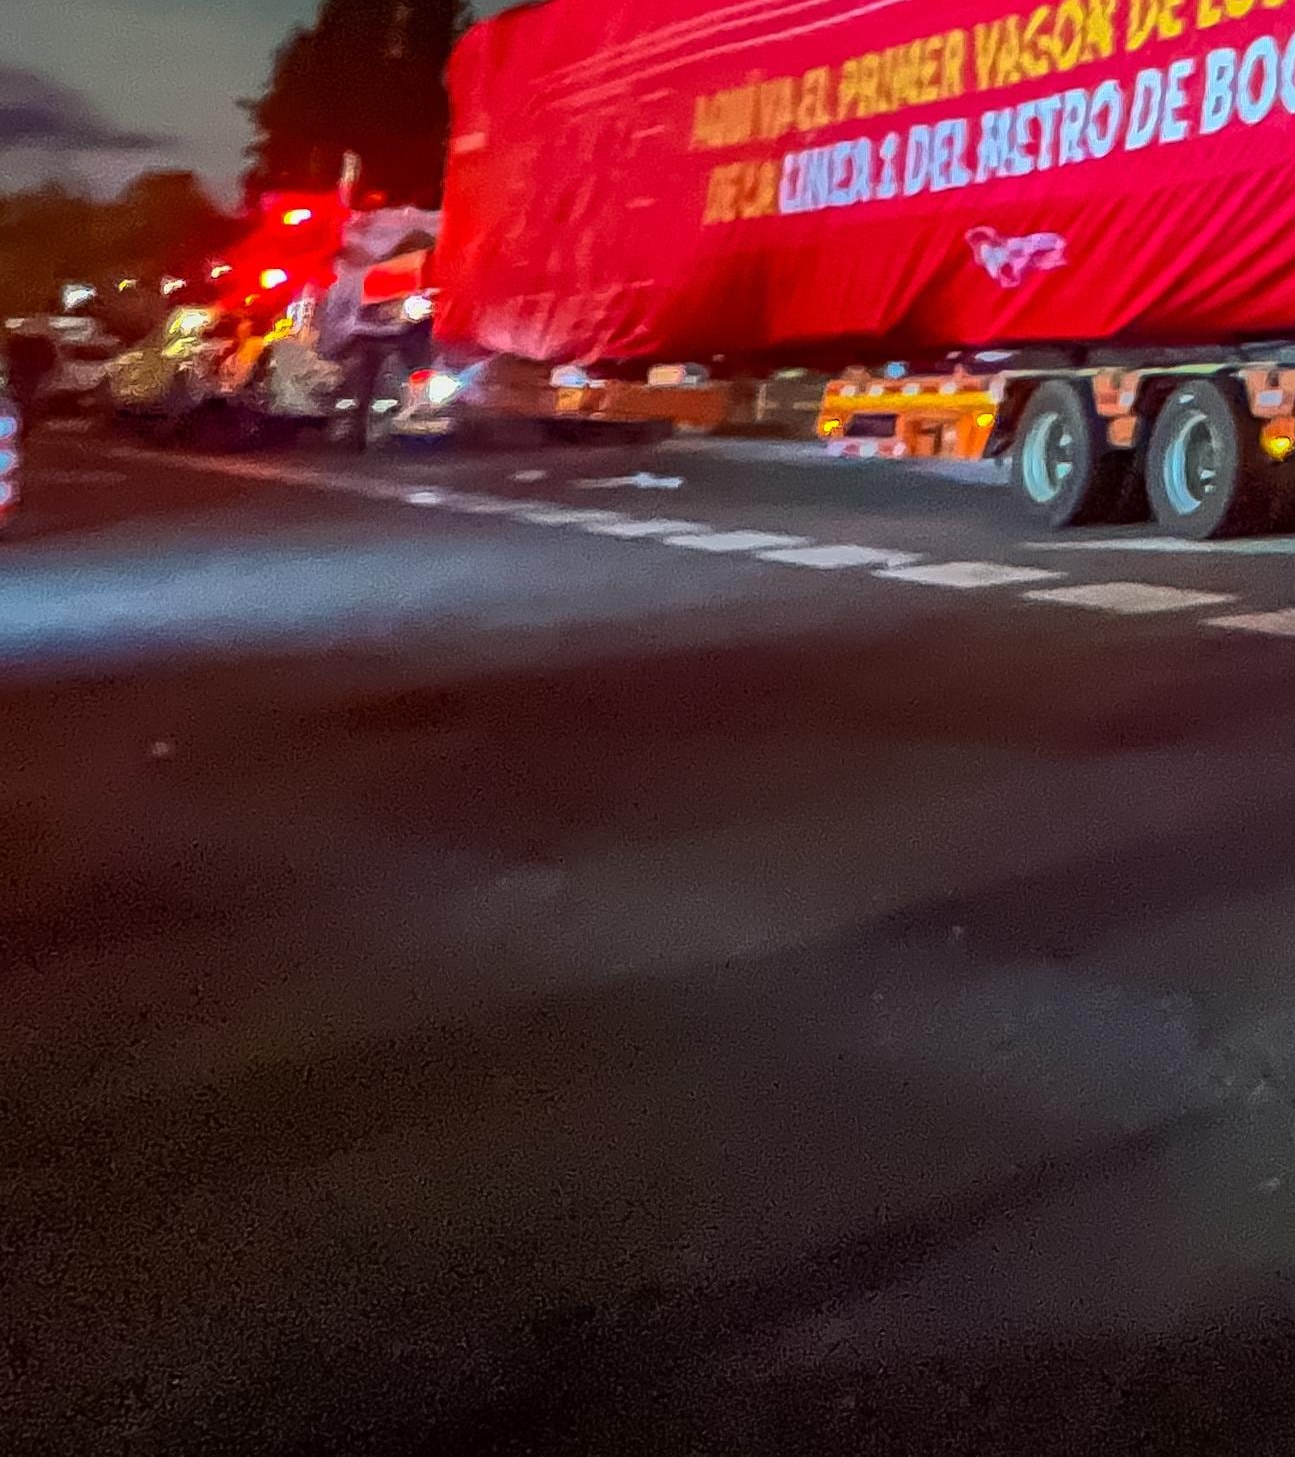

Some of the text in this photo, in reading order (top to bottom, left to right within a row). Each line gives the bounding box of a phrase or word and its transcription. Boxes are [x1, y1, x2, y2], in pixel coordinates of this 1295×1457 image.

[836, 28, 967, 122] PRIMER
[901, 117, 971, 197] DEL
[974, 79, 1124, 183] METRO
[1124, 56, 1197, 152] DE
